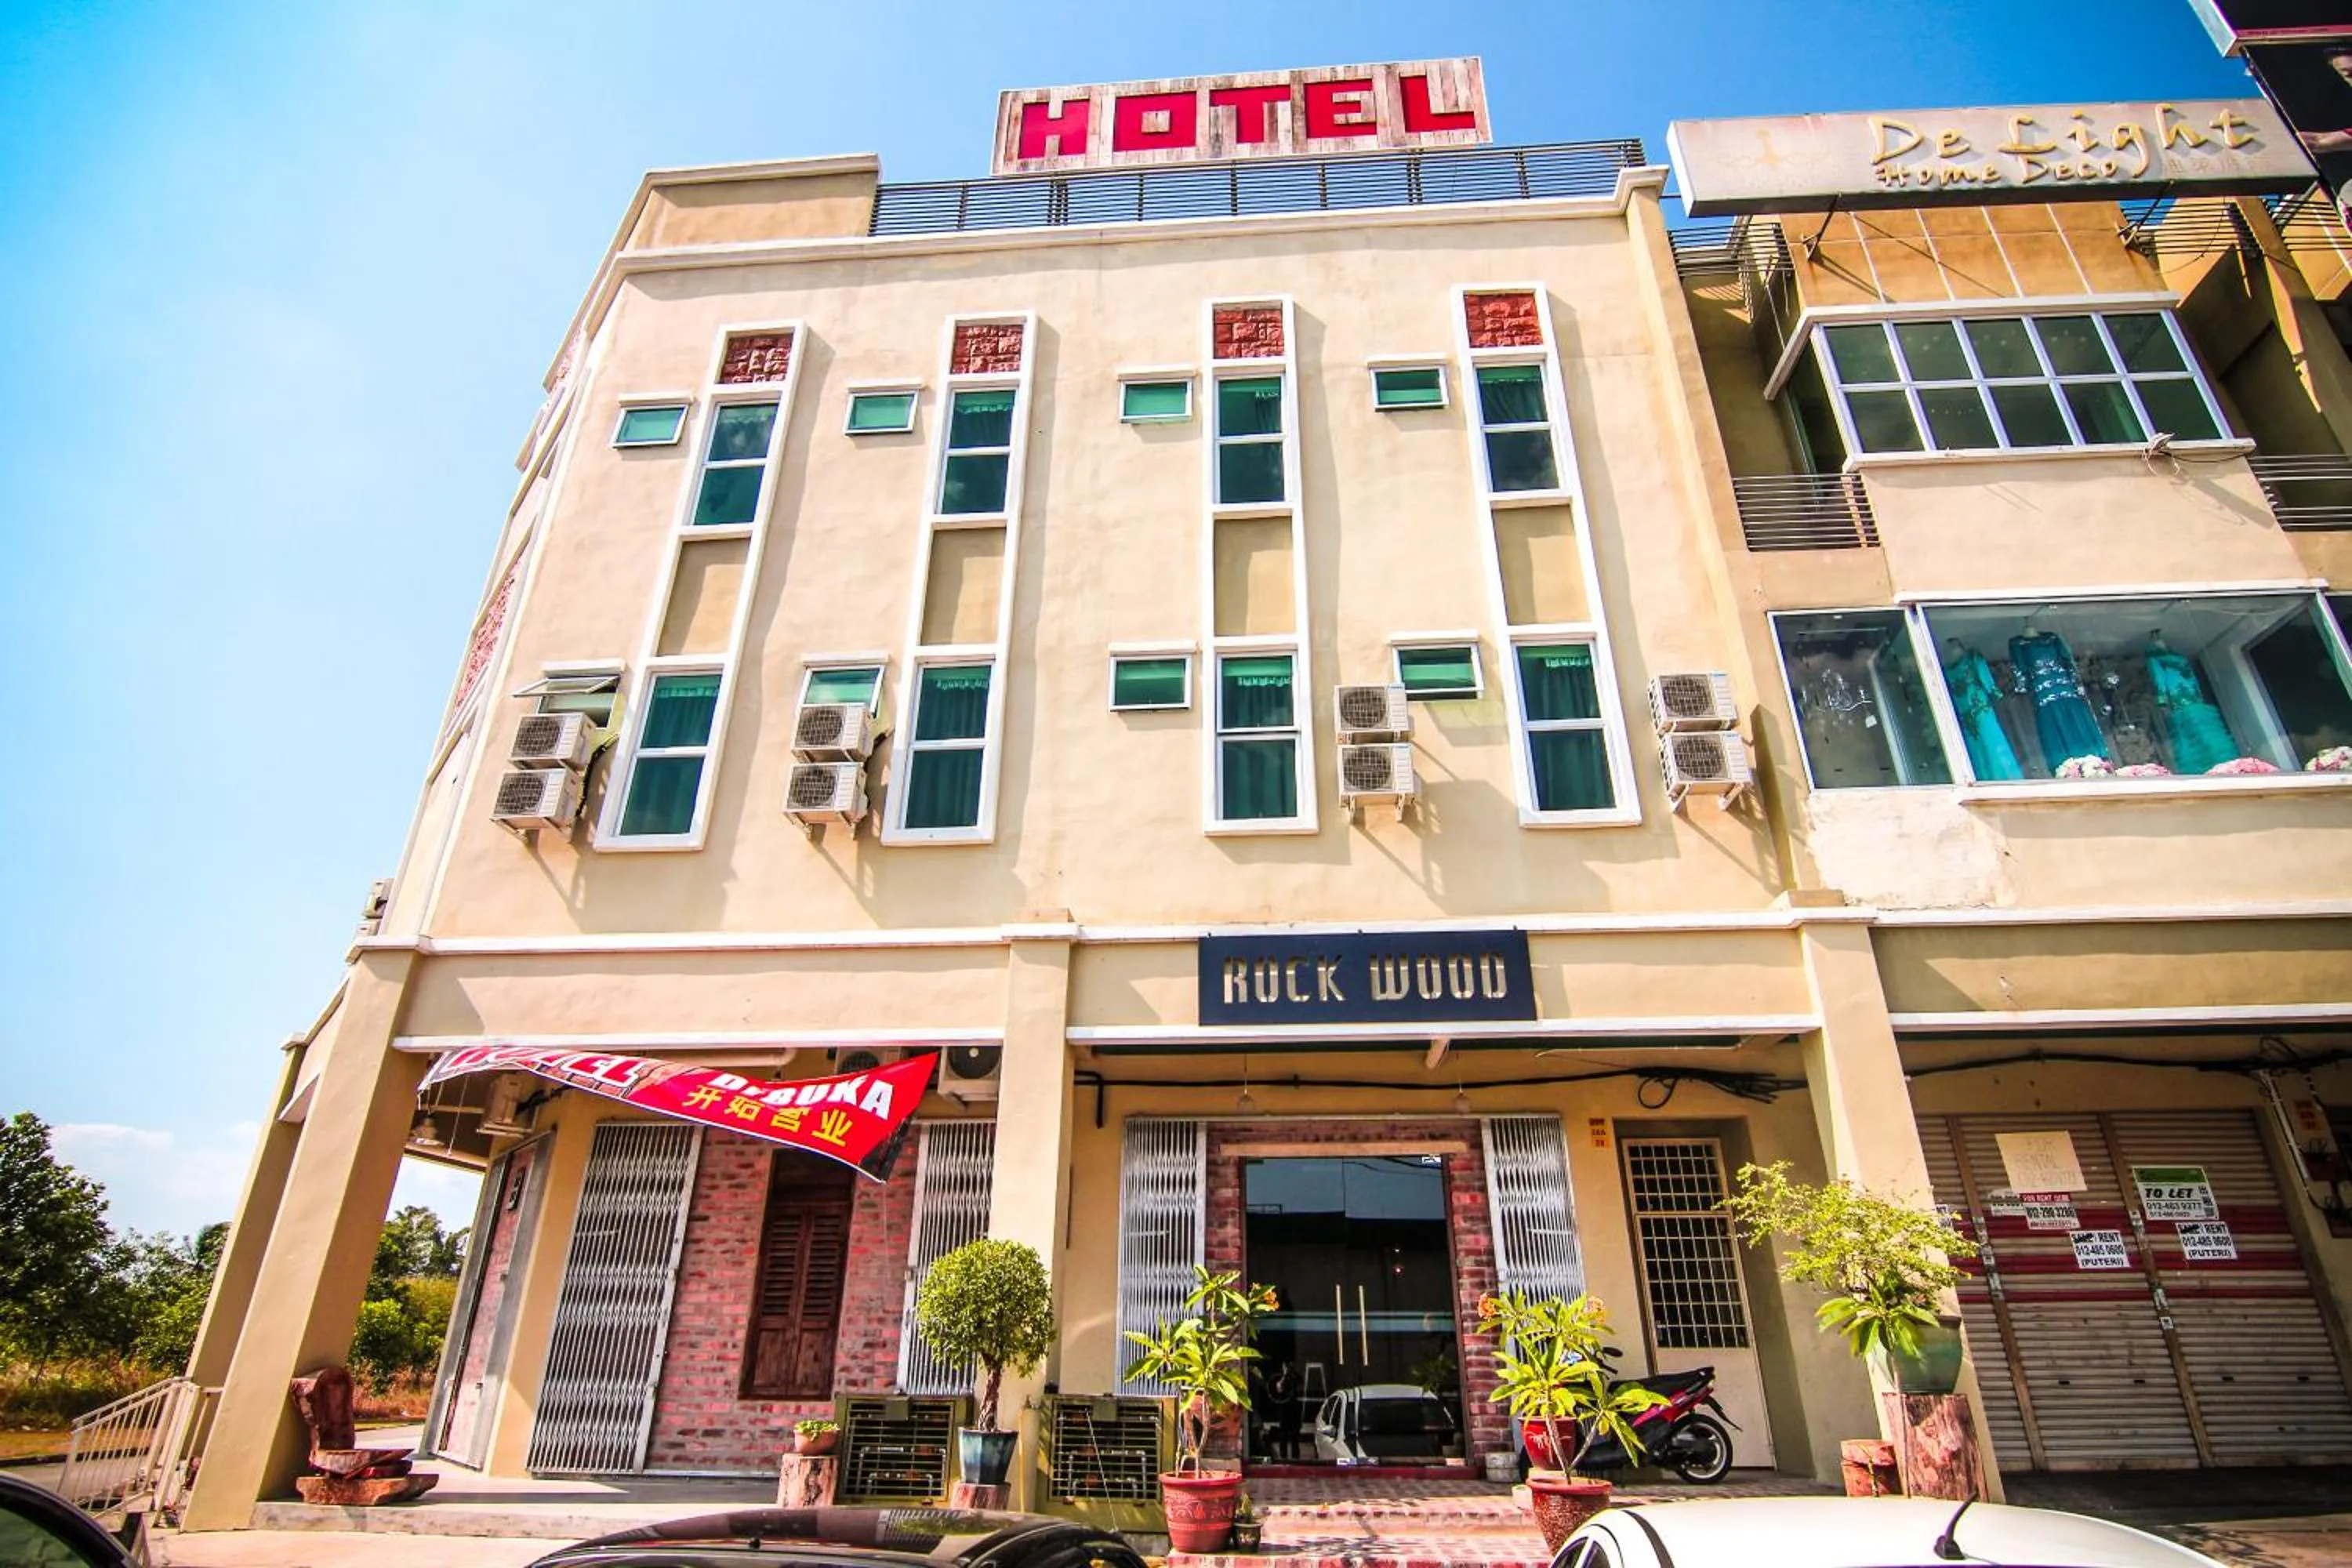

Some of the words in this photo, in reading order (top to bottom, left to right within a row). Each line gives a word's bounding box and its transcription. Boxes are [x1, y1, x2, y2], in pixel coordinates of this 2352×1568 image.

[1018, 74, 1475, 160] HOTEL
[1867, 117, 1970, 165] De
[1876, 163, 2000, 187] Home
[2016, 154, 2118, 184] Deco
[1223, 954, 1346, 1004] ROCK
[1370, 952, 1508, 1002] WOOD
[2145, 1188, 2163, 1198] TO
[2168, 1188, 2193, 1198] LET
[2204, 1224, 2227, 1234] RENT
[2097, 1232, 2121, 1243] RENT
[2189, 1249, 2232, 1258] (PUTERI)
[2082, 1257, 2124, 1267] (PUTERI)
